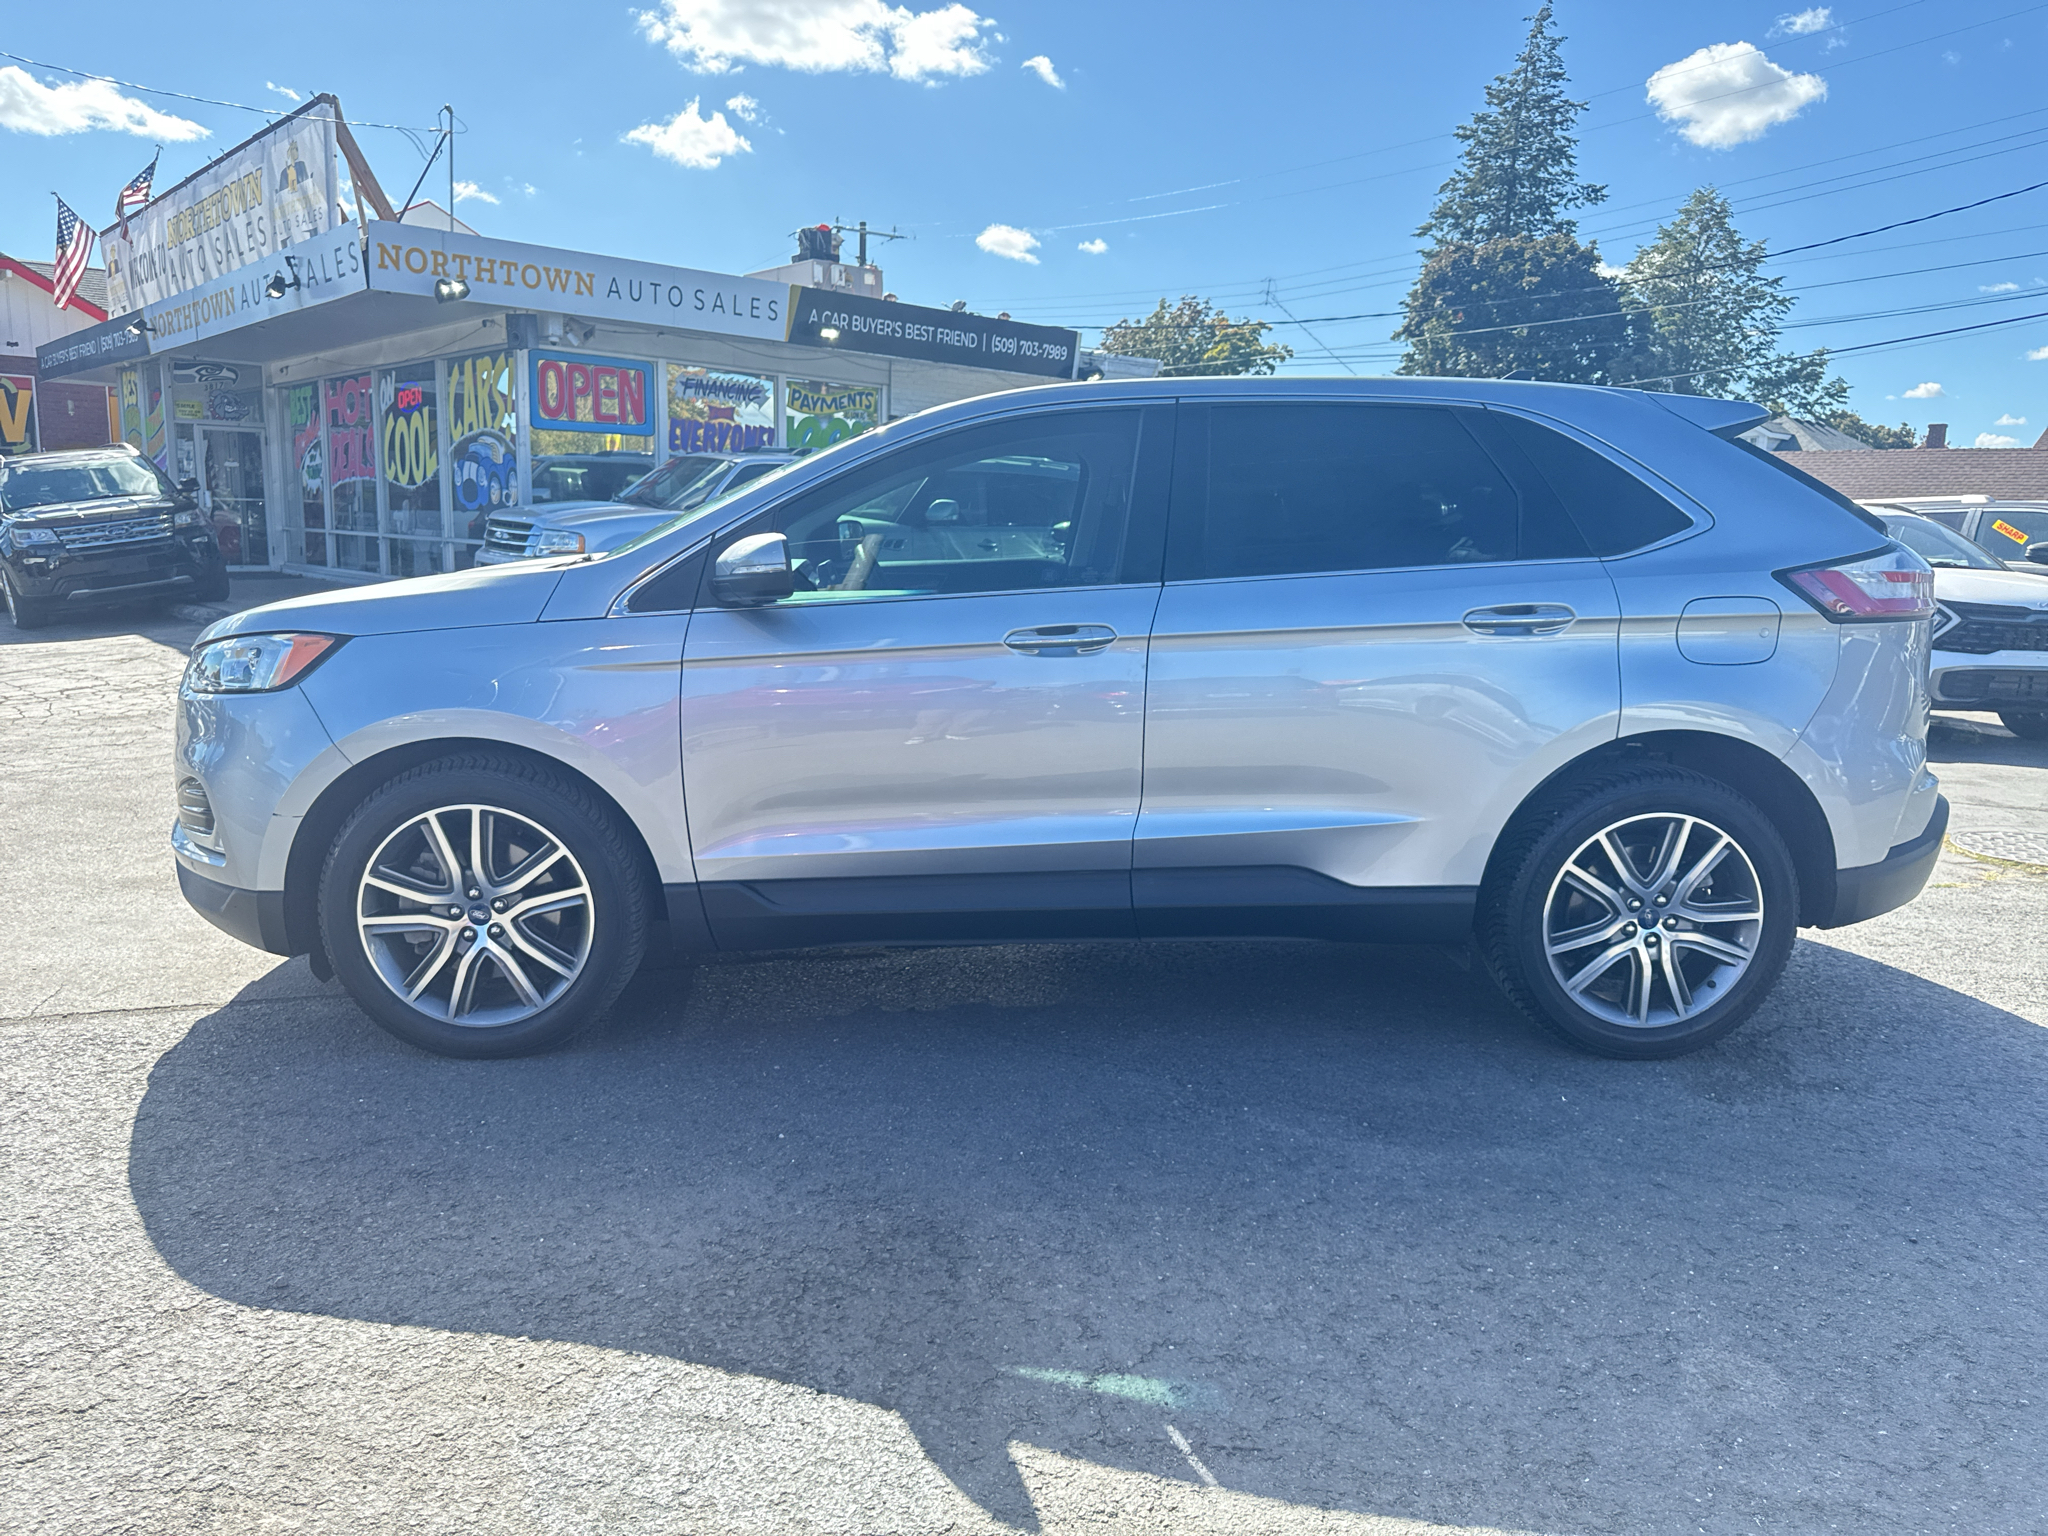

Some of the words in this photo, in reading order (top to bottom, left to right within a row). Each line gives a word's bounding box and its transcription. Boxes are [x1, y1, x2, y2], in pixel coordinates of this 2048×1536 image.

[167, 167, 263, 250] NORTHTOWN
[171, 245, 206, 285] AUTO
[214, 215, 267, 265] SALES
[377, 242, 595, 297] NORTHTOWN
[607, 276, 683, 307] AUTO
[694, 289, 778, 321] SALES
[149, 286, 235, 340] NORTHTOWN
[241, 269, 283, 310] AUT
[292, 241, 359, 292] ALES
[808, 309, 818, 324] A
[822, 310, 849, 330] CAR
[852, 314, 903, 338] BUYER'S
[905, 322, 935, 341] BEST
[937, 328, 977, 348] FRIEND
[991, 333, 1018, 356] (509)
[1019, 339, 1068, 361] 703-7989
[325, 376, 372, 425] HOT
[398, 387, 422, 409] OPEN
[449, 352, 514, 442] CARS!
[537, 359, 646, 425] OPEN
[682, 376, 762, 402] FINANCING
[791, 388, 875, 412] PAYMENTS
[331, 422, 376, 484] DEALS
[384, 405, 437, 485] COOL
[1996, 522, 2025, 541] SHARP
